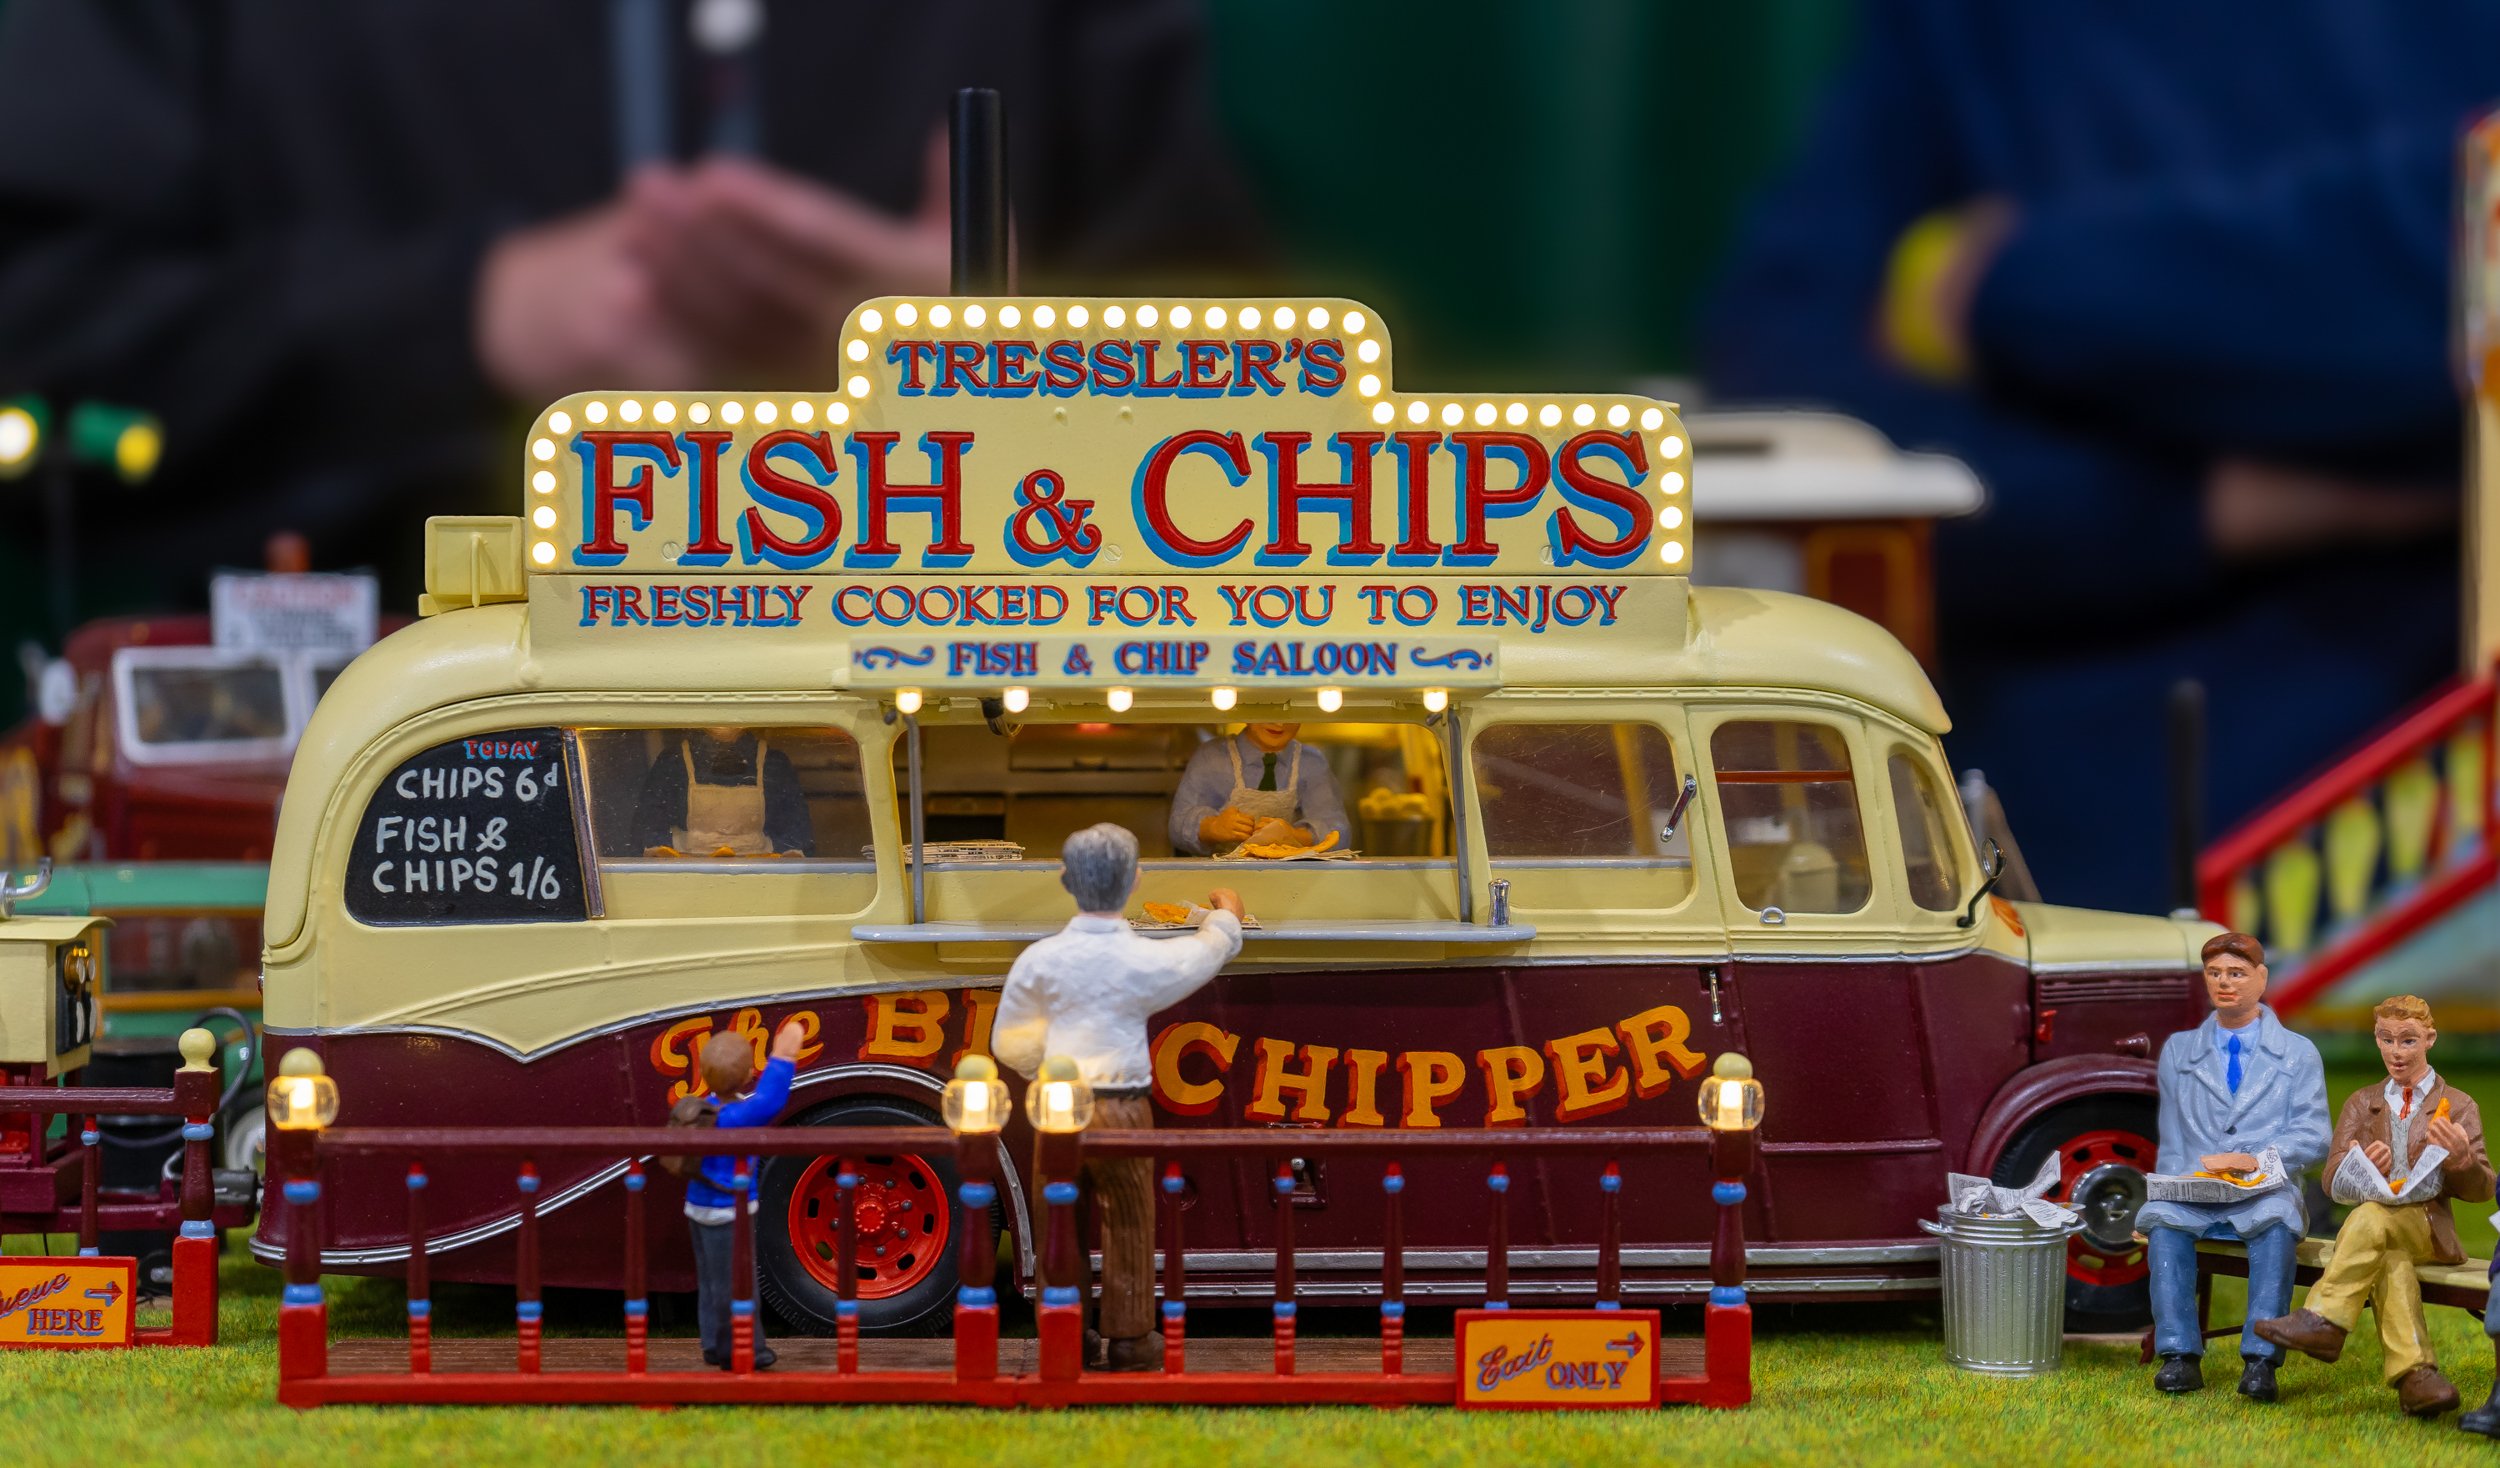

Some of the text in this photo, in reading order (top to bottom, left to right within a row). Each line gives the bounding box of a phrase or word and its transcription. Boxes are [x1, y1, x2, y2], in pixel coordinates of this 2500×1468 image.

[886, 339, 1347, 398] TRESSLER'S
[570, 429, 1654, 570] FISH & CHIPS
[578, 585, 1628, 633] FRESHLY COOKED FOR YOU TO ENJOY
[946, 640, 1398, 677] FISH & CHIP SALOON
[463, 739, 540, 761] TODAY
[395, 766, 506, 800] CHIPS
[375, 815, 509, 854] FISH &
[372, 856, 561, 901] CHIPS 1/6
[650, 1006, 825, 1108] The
[1149, 1004, 1706, 1128] CHIPPER
[0, 1272, 72, 1319] ueue
[27, 1308, 104, 1337] HERE
[1476, 1333, 1554, 1392] Exit
[1546, 1360, 1629, 1390] ONLY
